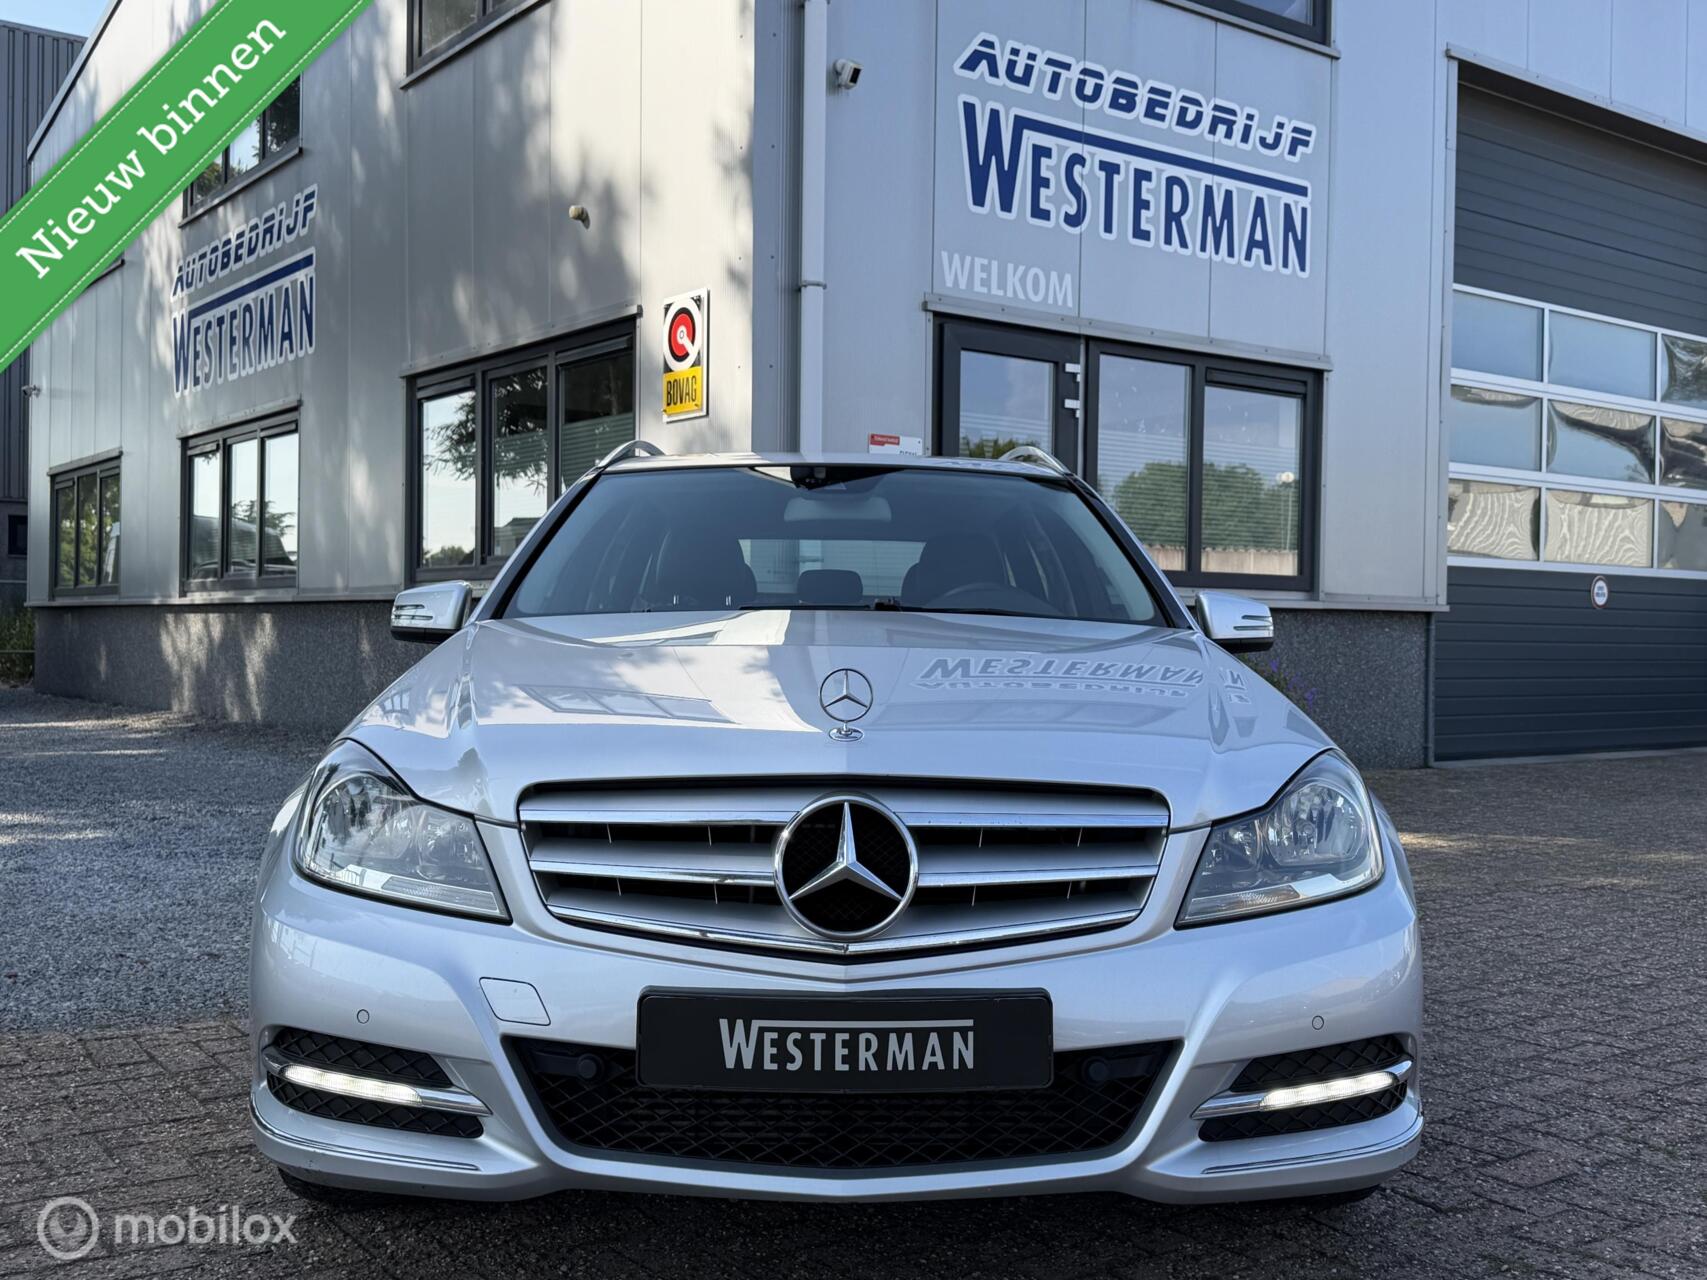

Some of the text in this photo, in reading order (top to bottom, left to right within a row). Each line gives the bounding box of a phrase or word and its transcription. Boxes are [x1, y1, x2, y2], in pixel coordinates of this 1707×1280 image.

[957, 37, 1313, 158] AUTOBEDRIJF
[171, 187, 317, 298] AUTOBEDRIJF
[940, 250, 1074, 308] WELKOM
[666, 375, 697, 407] BOVAG
